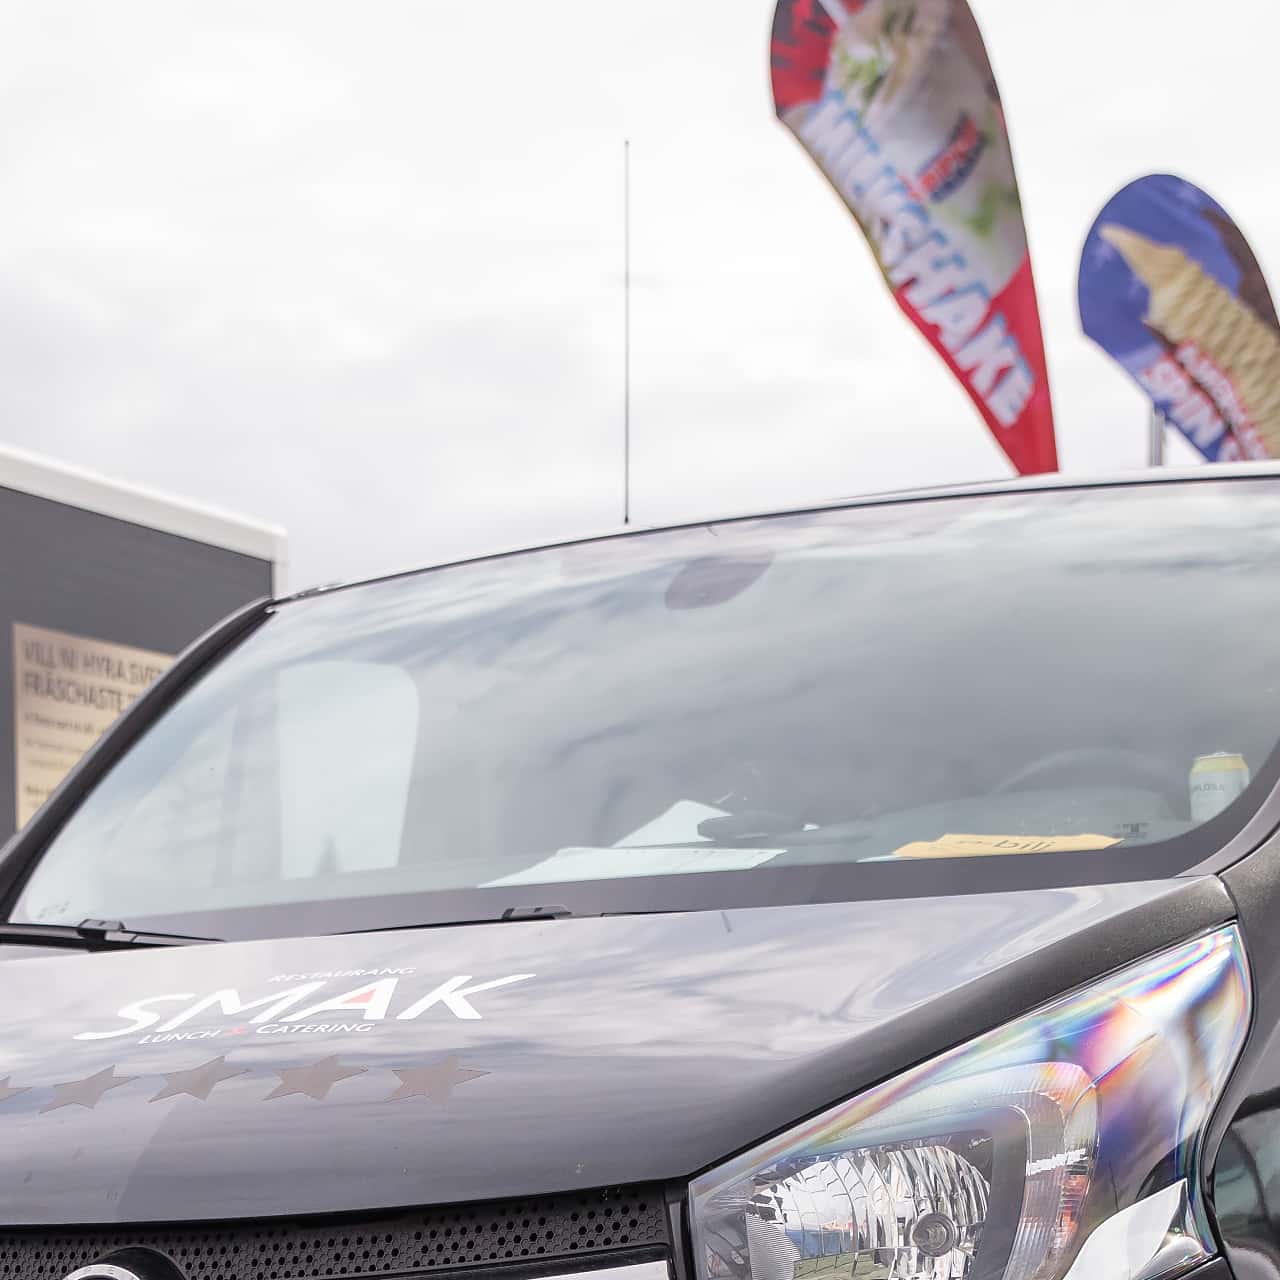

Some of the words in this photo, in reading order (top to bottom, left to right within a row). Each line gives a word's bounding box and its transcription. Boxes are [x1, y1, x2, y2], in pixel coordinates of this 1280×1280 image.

[72, 973, 537, 1041] SMAK
[137, 1029, 222, 1045] LUNCH
[255, 1023, 376, 1035] CATERING
